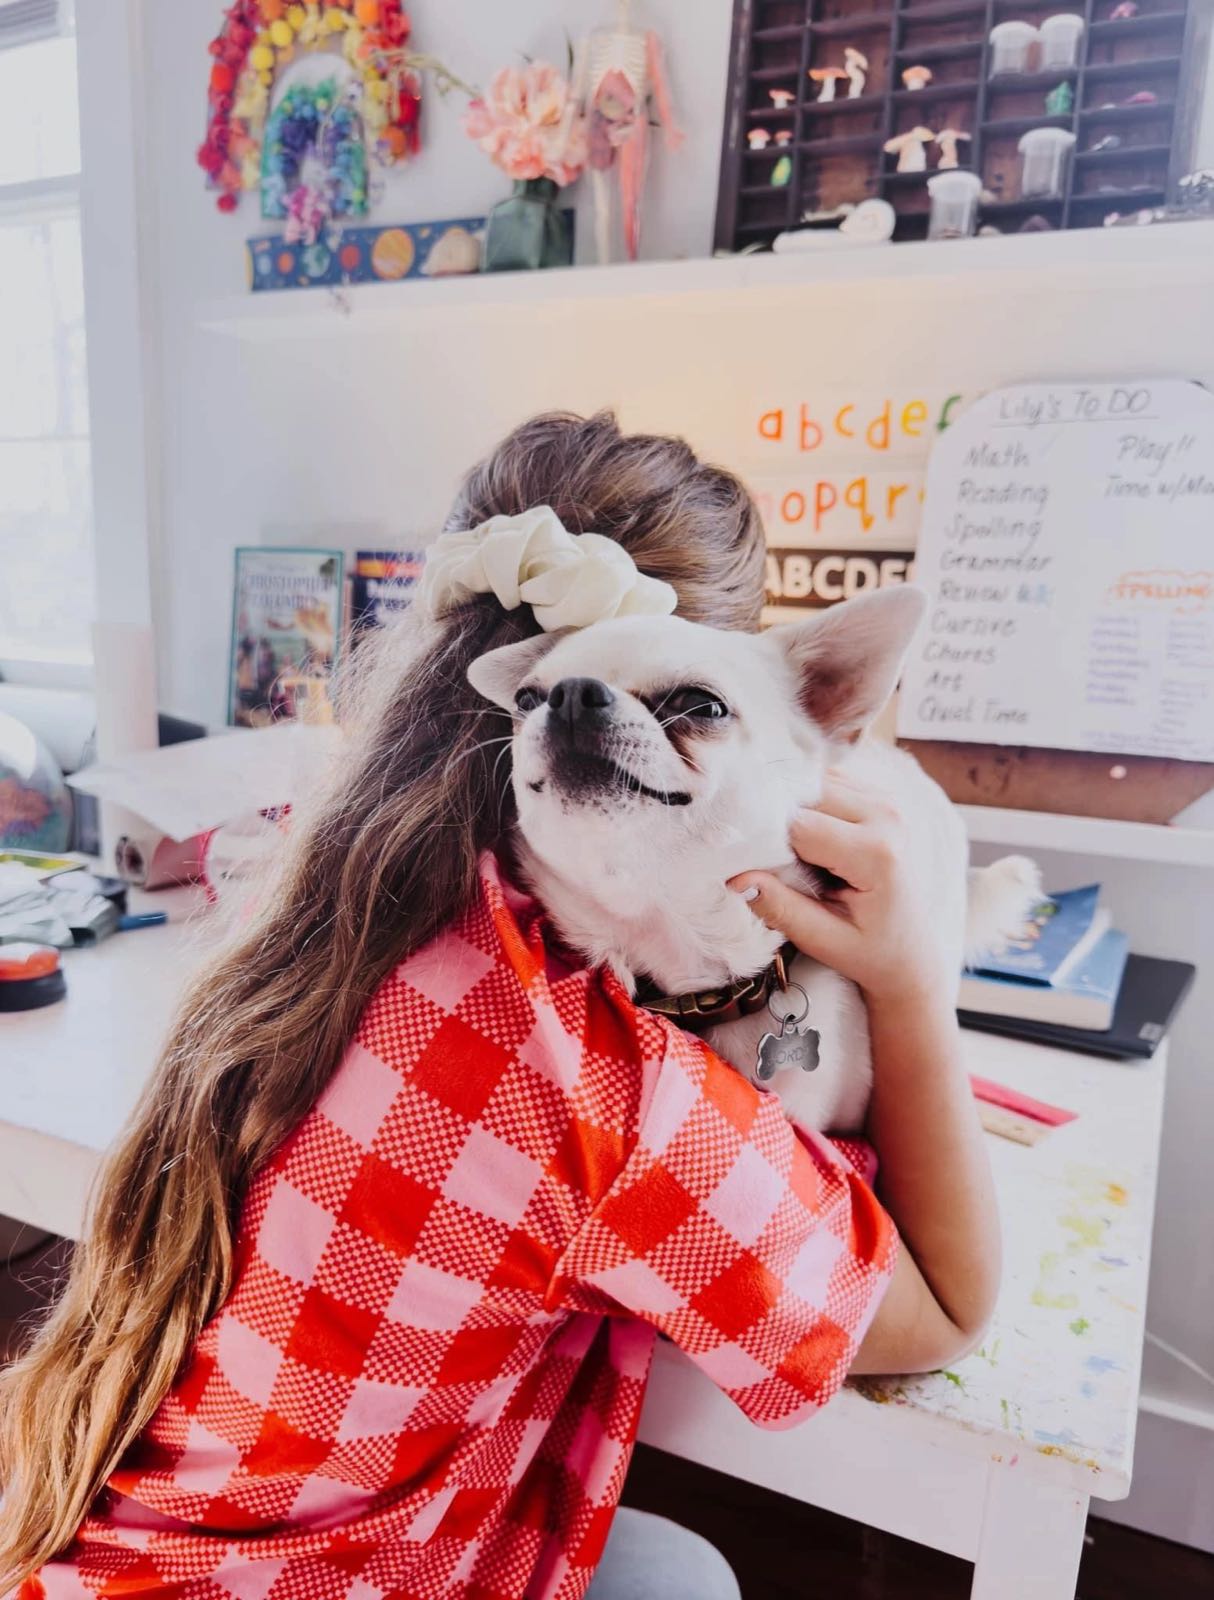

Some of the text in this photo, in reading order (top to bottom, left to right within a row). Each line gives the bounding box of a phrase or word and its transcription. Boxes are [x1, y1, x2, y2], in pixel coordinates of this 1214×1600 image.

[999, 387, 1152, 428] Lily's To DO
[962, 440, 1031, 468] Math
[956, 478, 1050, 516] Reading
[1104, 473, 1151, 499] Time
[943, 511, 1044, 556] Spelling
[939, 550, 1053, 573] Grammar
[940, 578, 1009, 602] Review
[931, 609, 1017, 636] Cursive
[922, 640, 997, 665] Chores
[925, 670, 965, 693] Art
[917, 695, 1030, 726] Quiet Time
